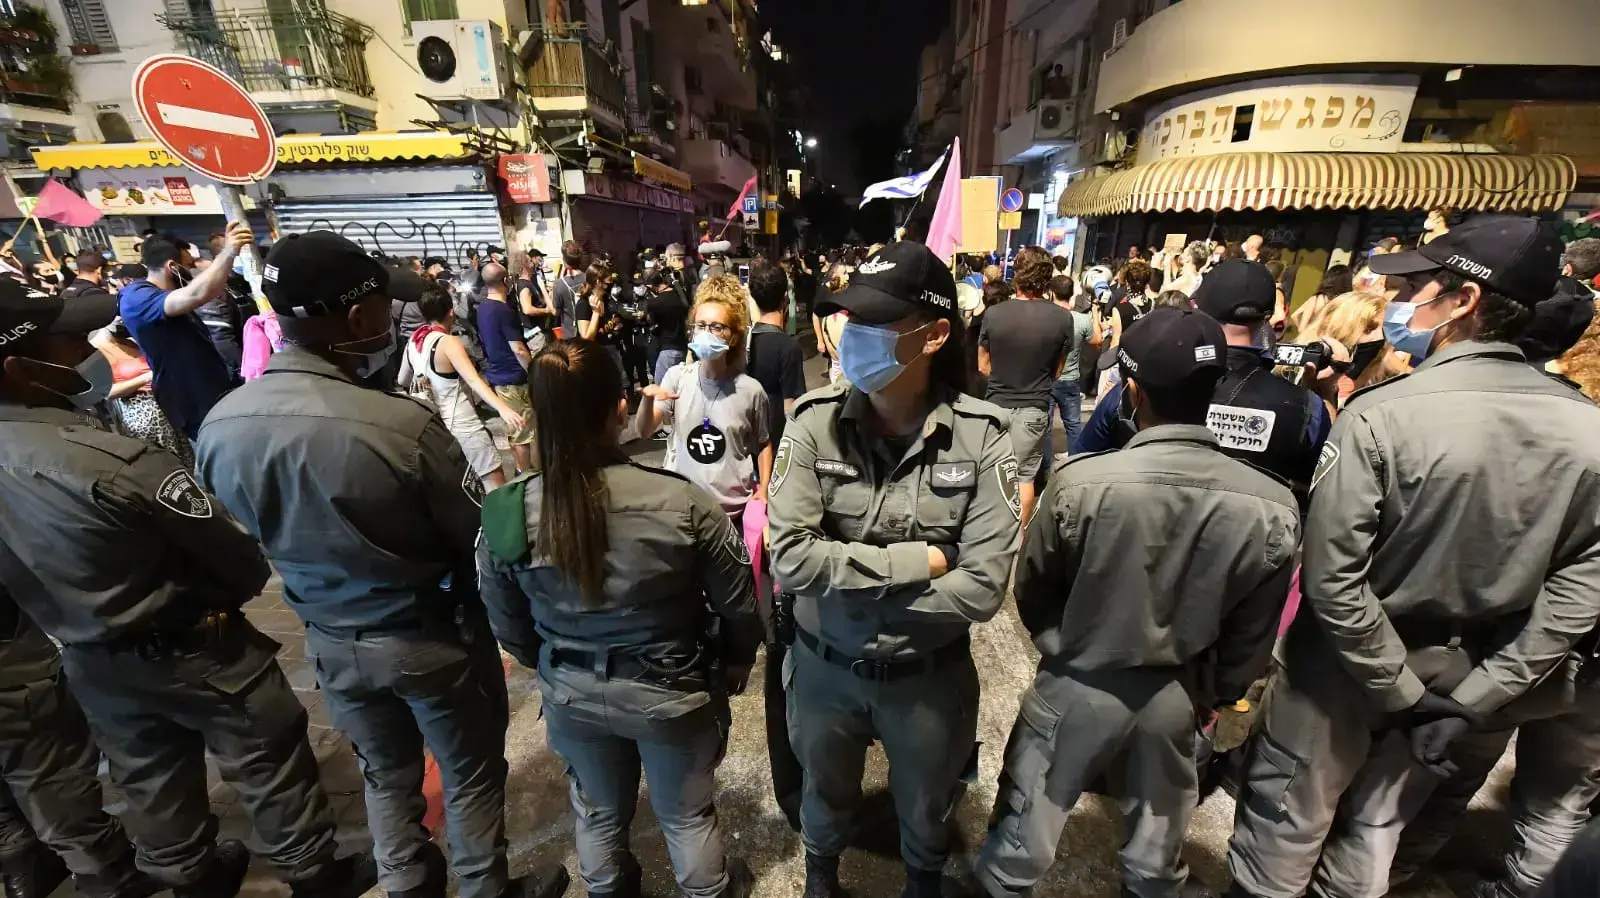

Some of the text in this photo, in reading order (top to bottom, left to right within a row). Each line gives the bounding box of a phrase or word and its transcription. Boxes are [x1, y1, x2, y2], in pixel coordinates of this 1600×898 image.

[1259, 95, 1376, 131] מפגש
[290, 142, 342, 160] פלורנטין
[346, 144, 370, 160] שוק
[339, 276, 379, 305] POLICE
[1208, 411, 1246, 423] משטרת
[1228, 434, 1262, 447] חוקר
